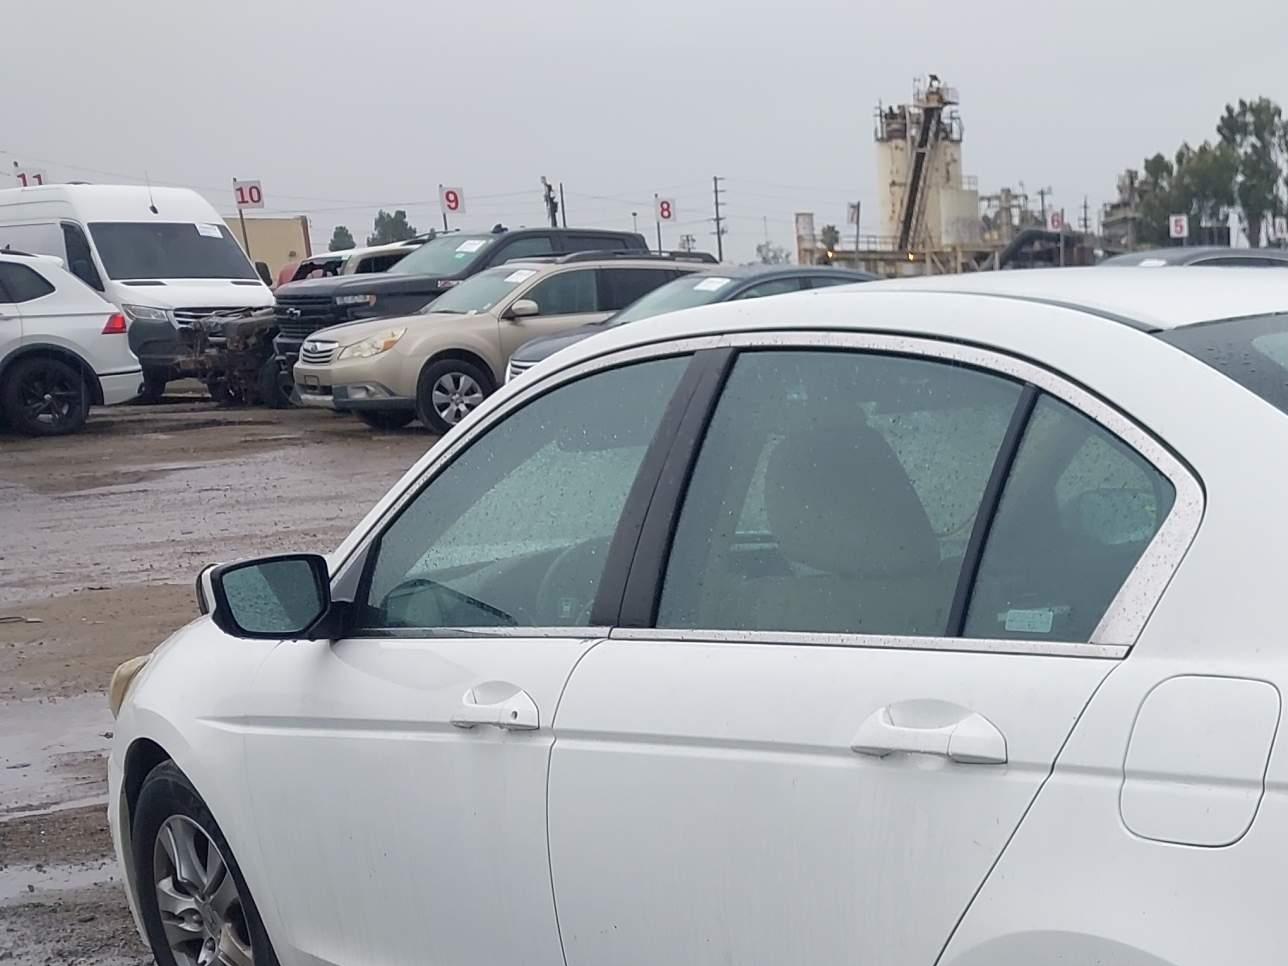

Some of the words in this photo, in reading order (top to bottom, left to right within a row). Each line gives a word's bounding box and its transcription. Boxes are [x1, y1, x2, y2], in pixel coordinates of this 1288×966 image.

[16, 172, 43, 187] 11
[235, 185, 262, 204] 10
[445, 190, 459, 210] 9
[660, 200, 672, 219] 8
[1051, 212, 1061, 230] 6
[1174, 219, 1184, 235] 5
